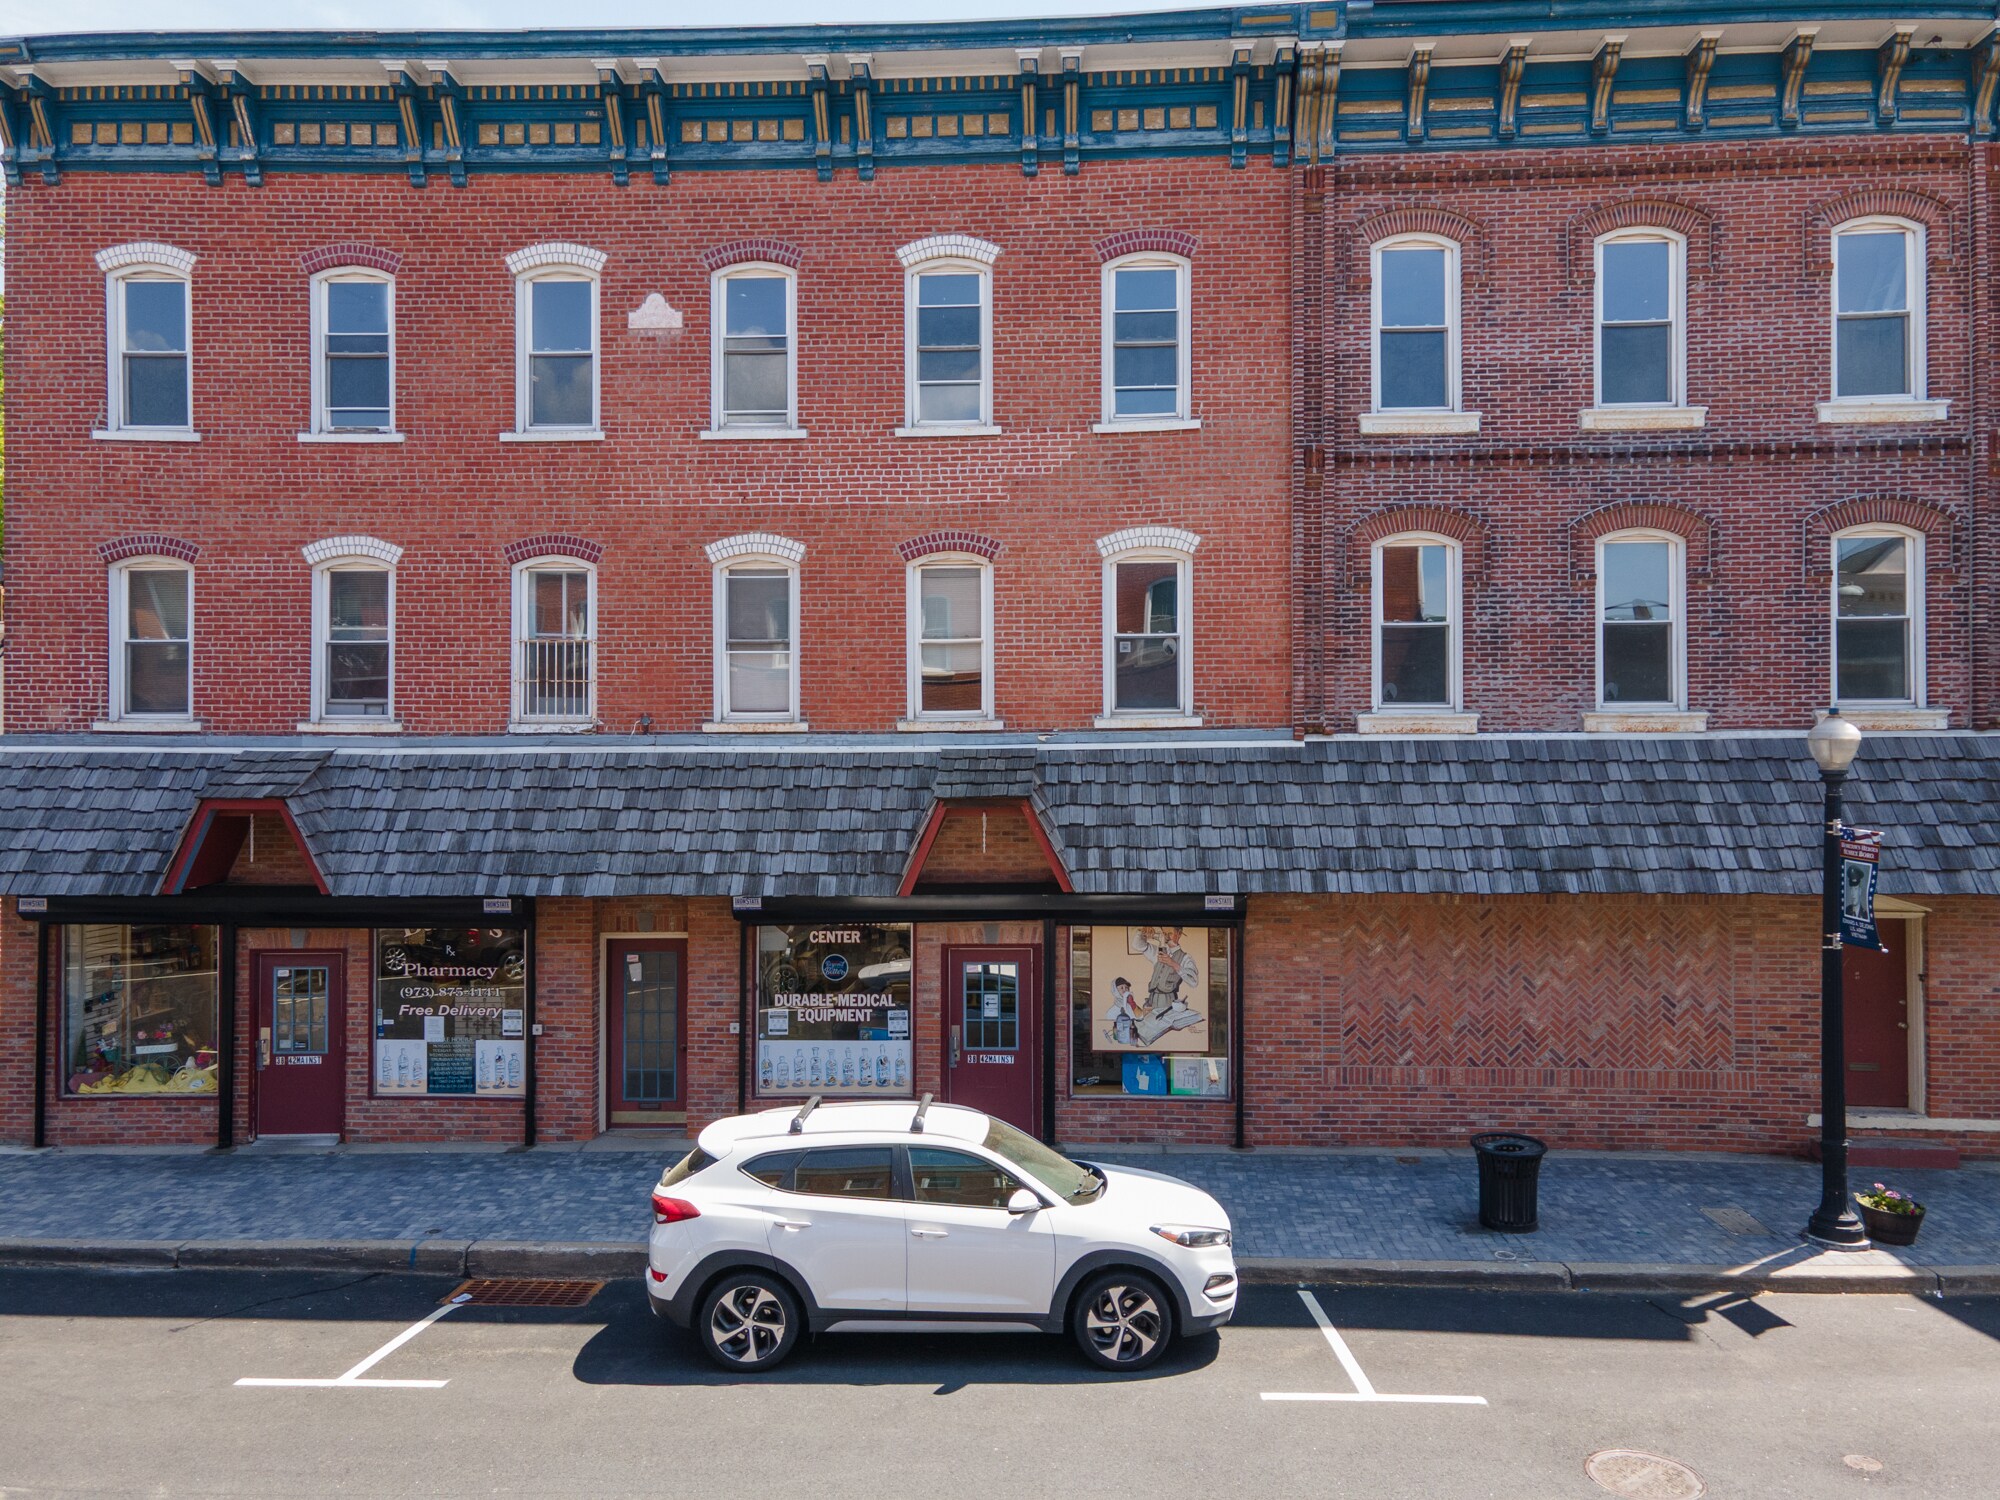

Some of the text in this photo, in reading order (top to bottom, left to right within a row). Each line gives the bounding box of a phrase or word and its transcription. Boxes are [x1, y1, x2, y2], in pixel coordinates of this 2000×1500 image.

[809, 930, 861, 944] CENTER
[402, 963, 498, 979] Pharmacy
[400, 987, 501, 999] (973) 875-4141
[774, 993, 896, 1007] DURABLE MEDICAL
[398, 1004, 502, 1019] Free Delivery
[797, 1008, 873, 1024] EQUIPMENT
